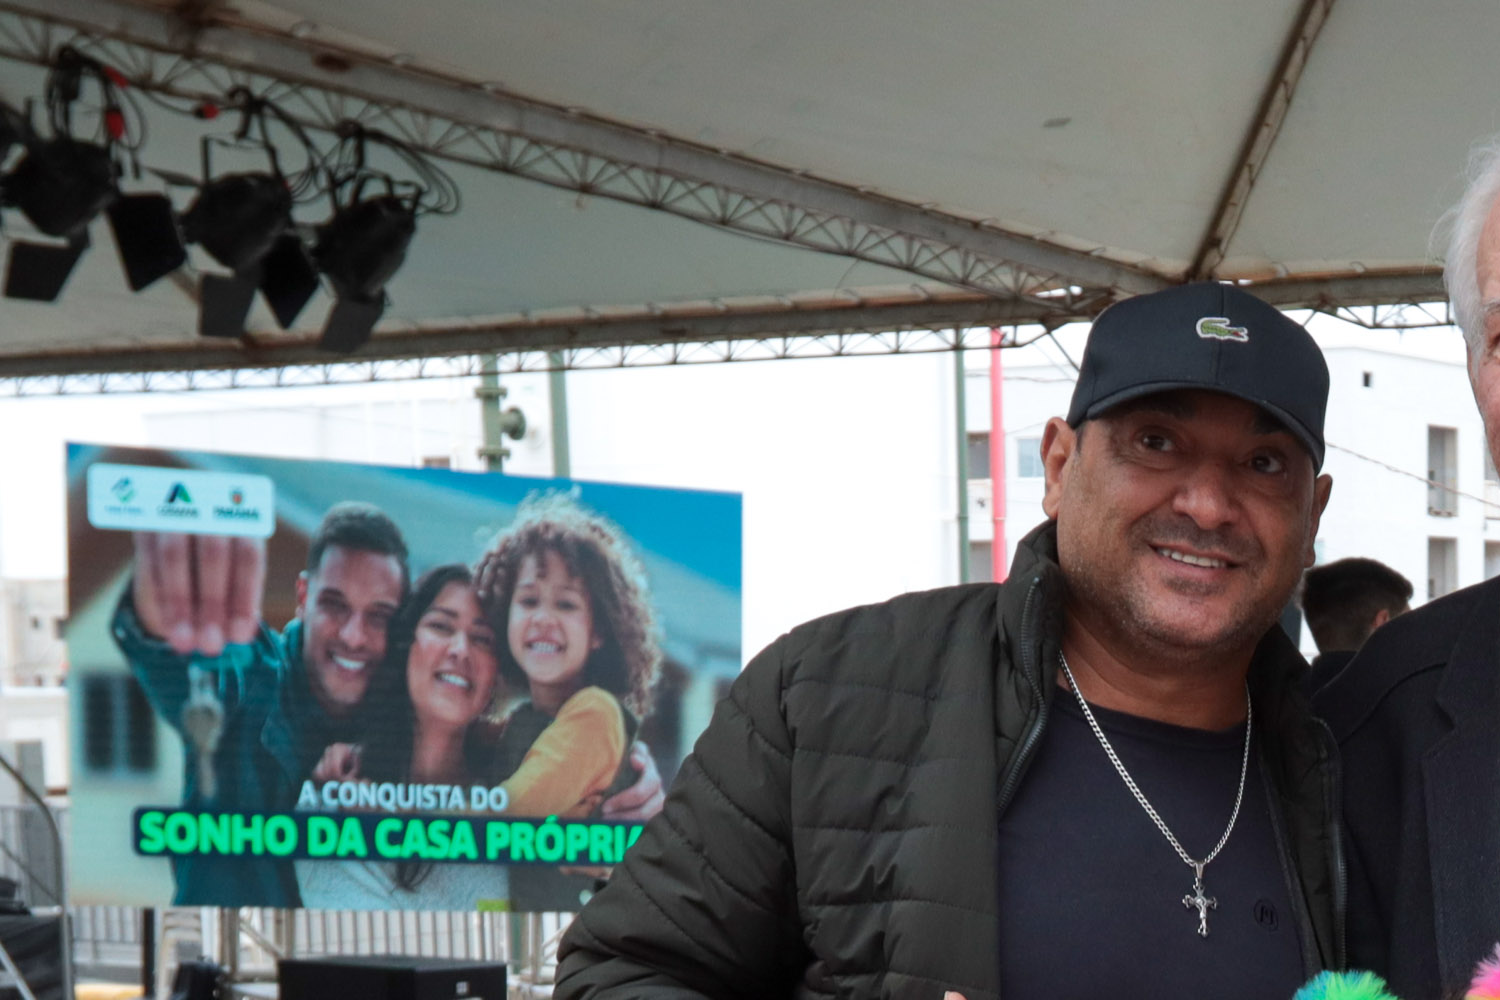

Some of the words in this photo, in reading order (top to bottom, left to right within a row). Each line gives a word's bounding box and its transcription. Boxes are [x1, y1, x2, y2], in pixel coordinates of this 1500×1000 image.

[298, 779, 318, 807] A
[321, 780, 466, 812] CONQUISTA
[470, 785, 509, 812] DO
[138, 810, 299, 857] SONHO
[306, 815, 369, 858] DA
[373, 817, 479, 860] CASA
